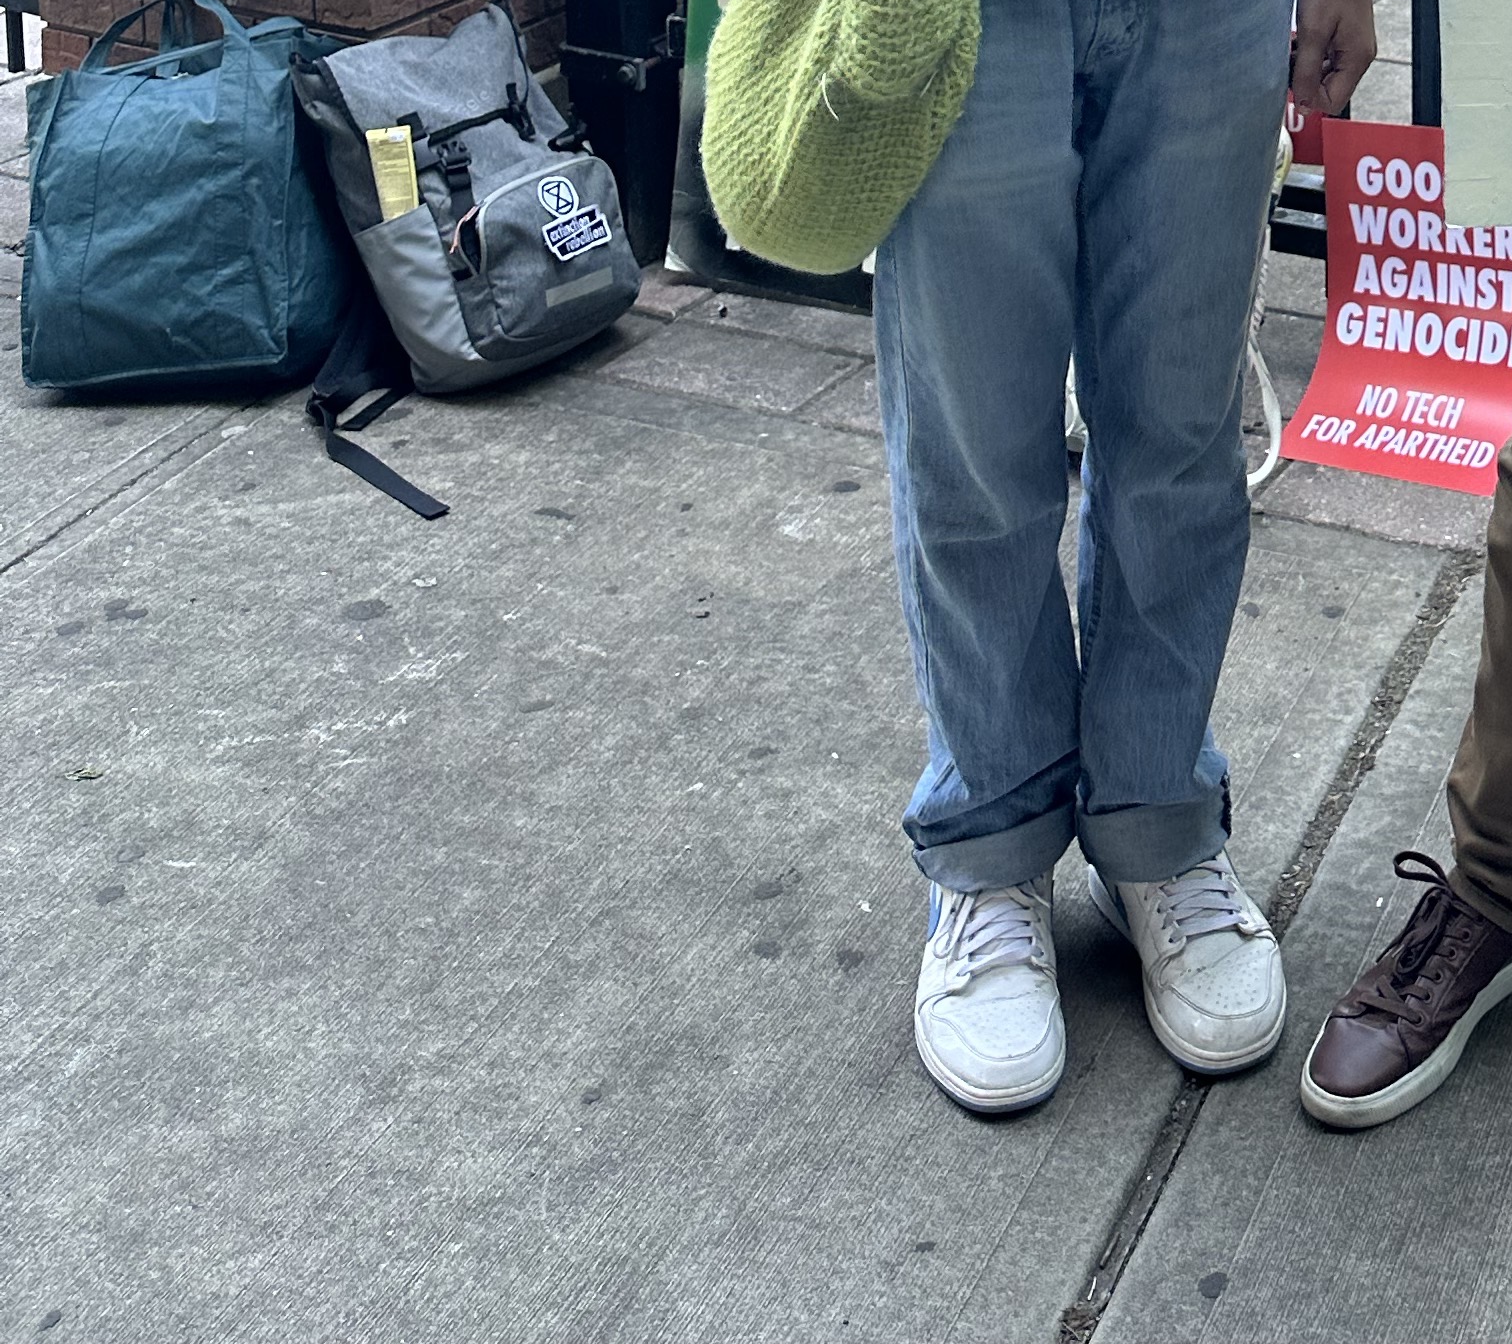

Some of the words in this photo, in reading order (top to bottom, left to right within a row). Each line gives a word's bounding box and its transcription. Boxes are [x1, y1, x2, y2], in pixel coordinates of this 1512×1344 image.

[1356, 155, 1441, 203] GOO
[565, 224, 607, 252] rebellion
[1356, 383, 1399, 419] NO
[1400, 389, 1466, 430] TECH
[1300, 413, 1357, 446] FOR
[1353, 423, 1497, 469] APARTHEID
